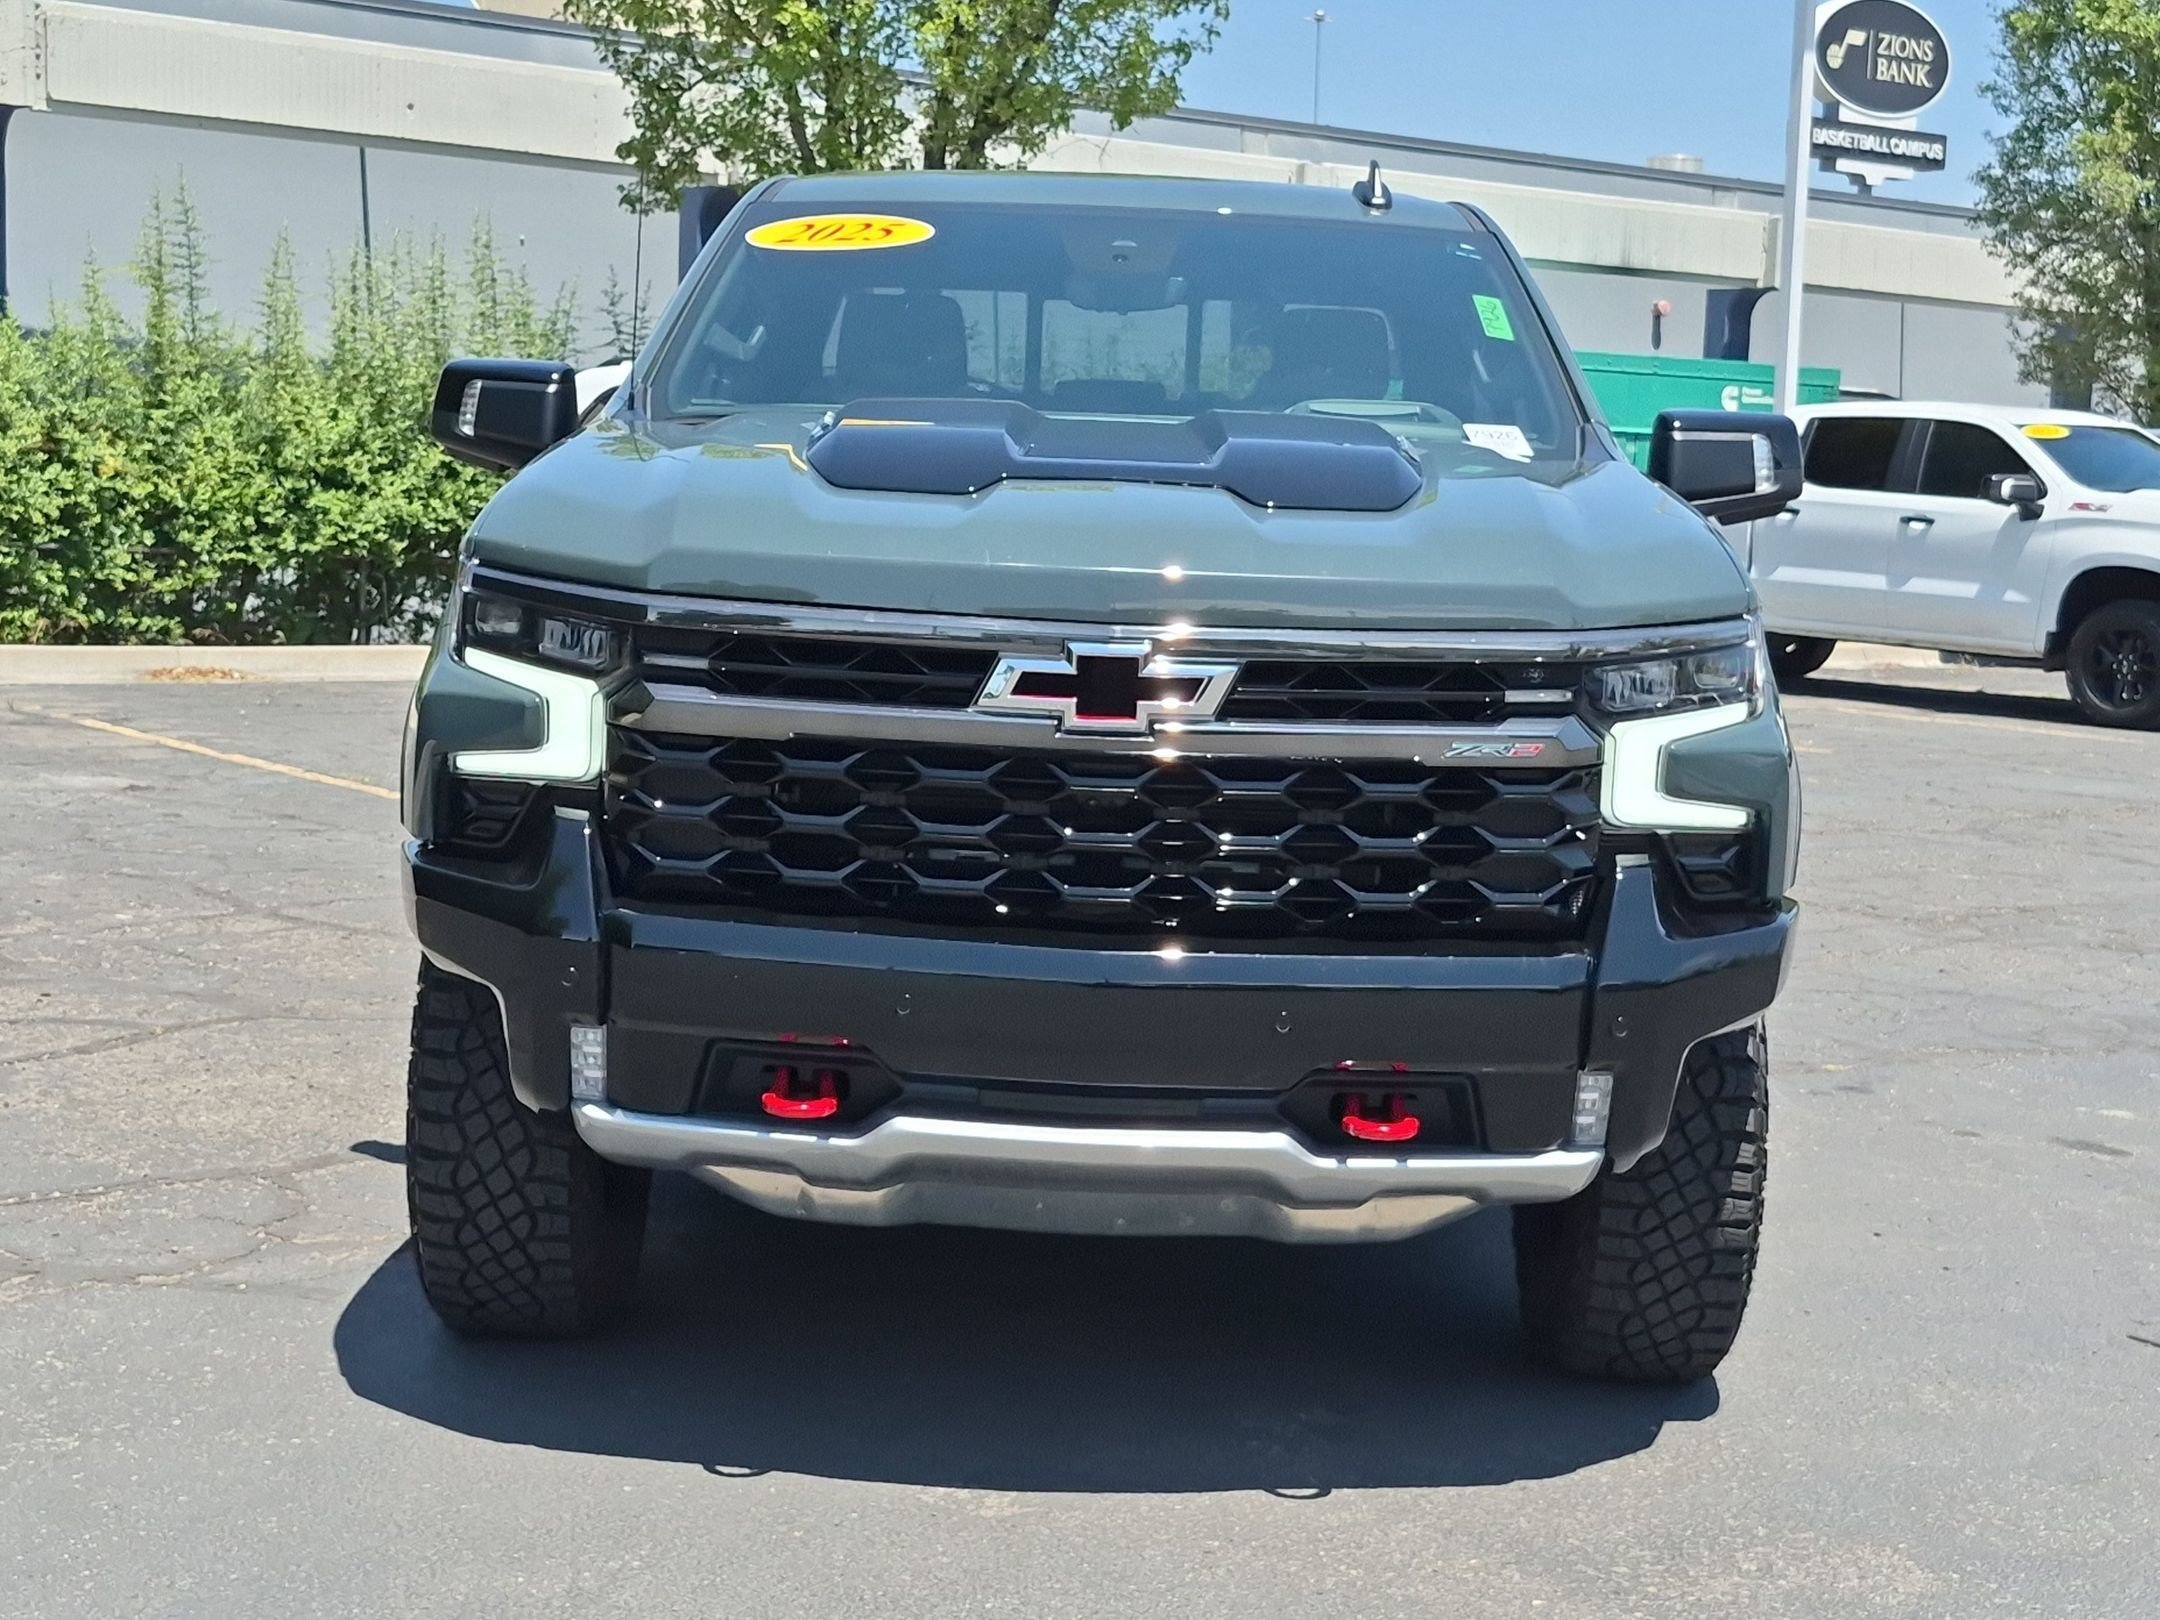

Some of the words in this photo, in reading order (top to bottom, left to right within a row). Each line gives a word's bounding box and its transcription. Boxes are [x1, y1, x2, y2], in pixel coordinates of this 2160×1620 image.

[1877, 32, 1933, 62] ZIONS
[1876, 58, 1932, 87] BANK
[1813, 128, 1890, 154] BASKETBALL
[1890, 138, 1943, 160] CAMPUS
[775, 223, 906, 243] 2025
[1441, 742, 1545, 758] ZR2
